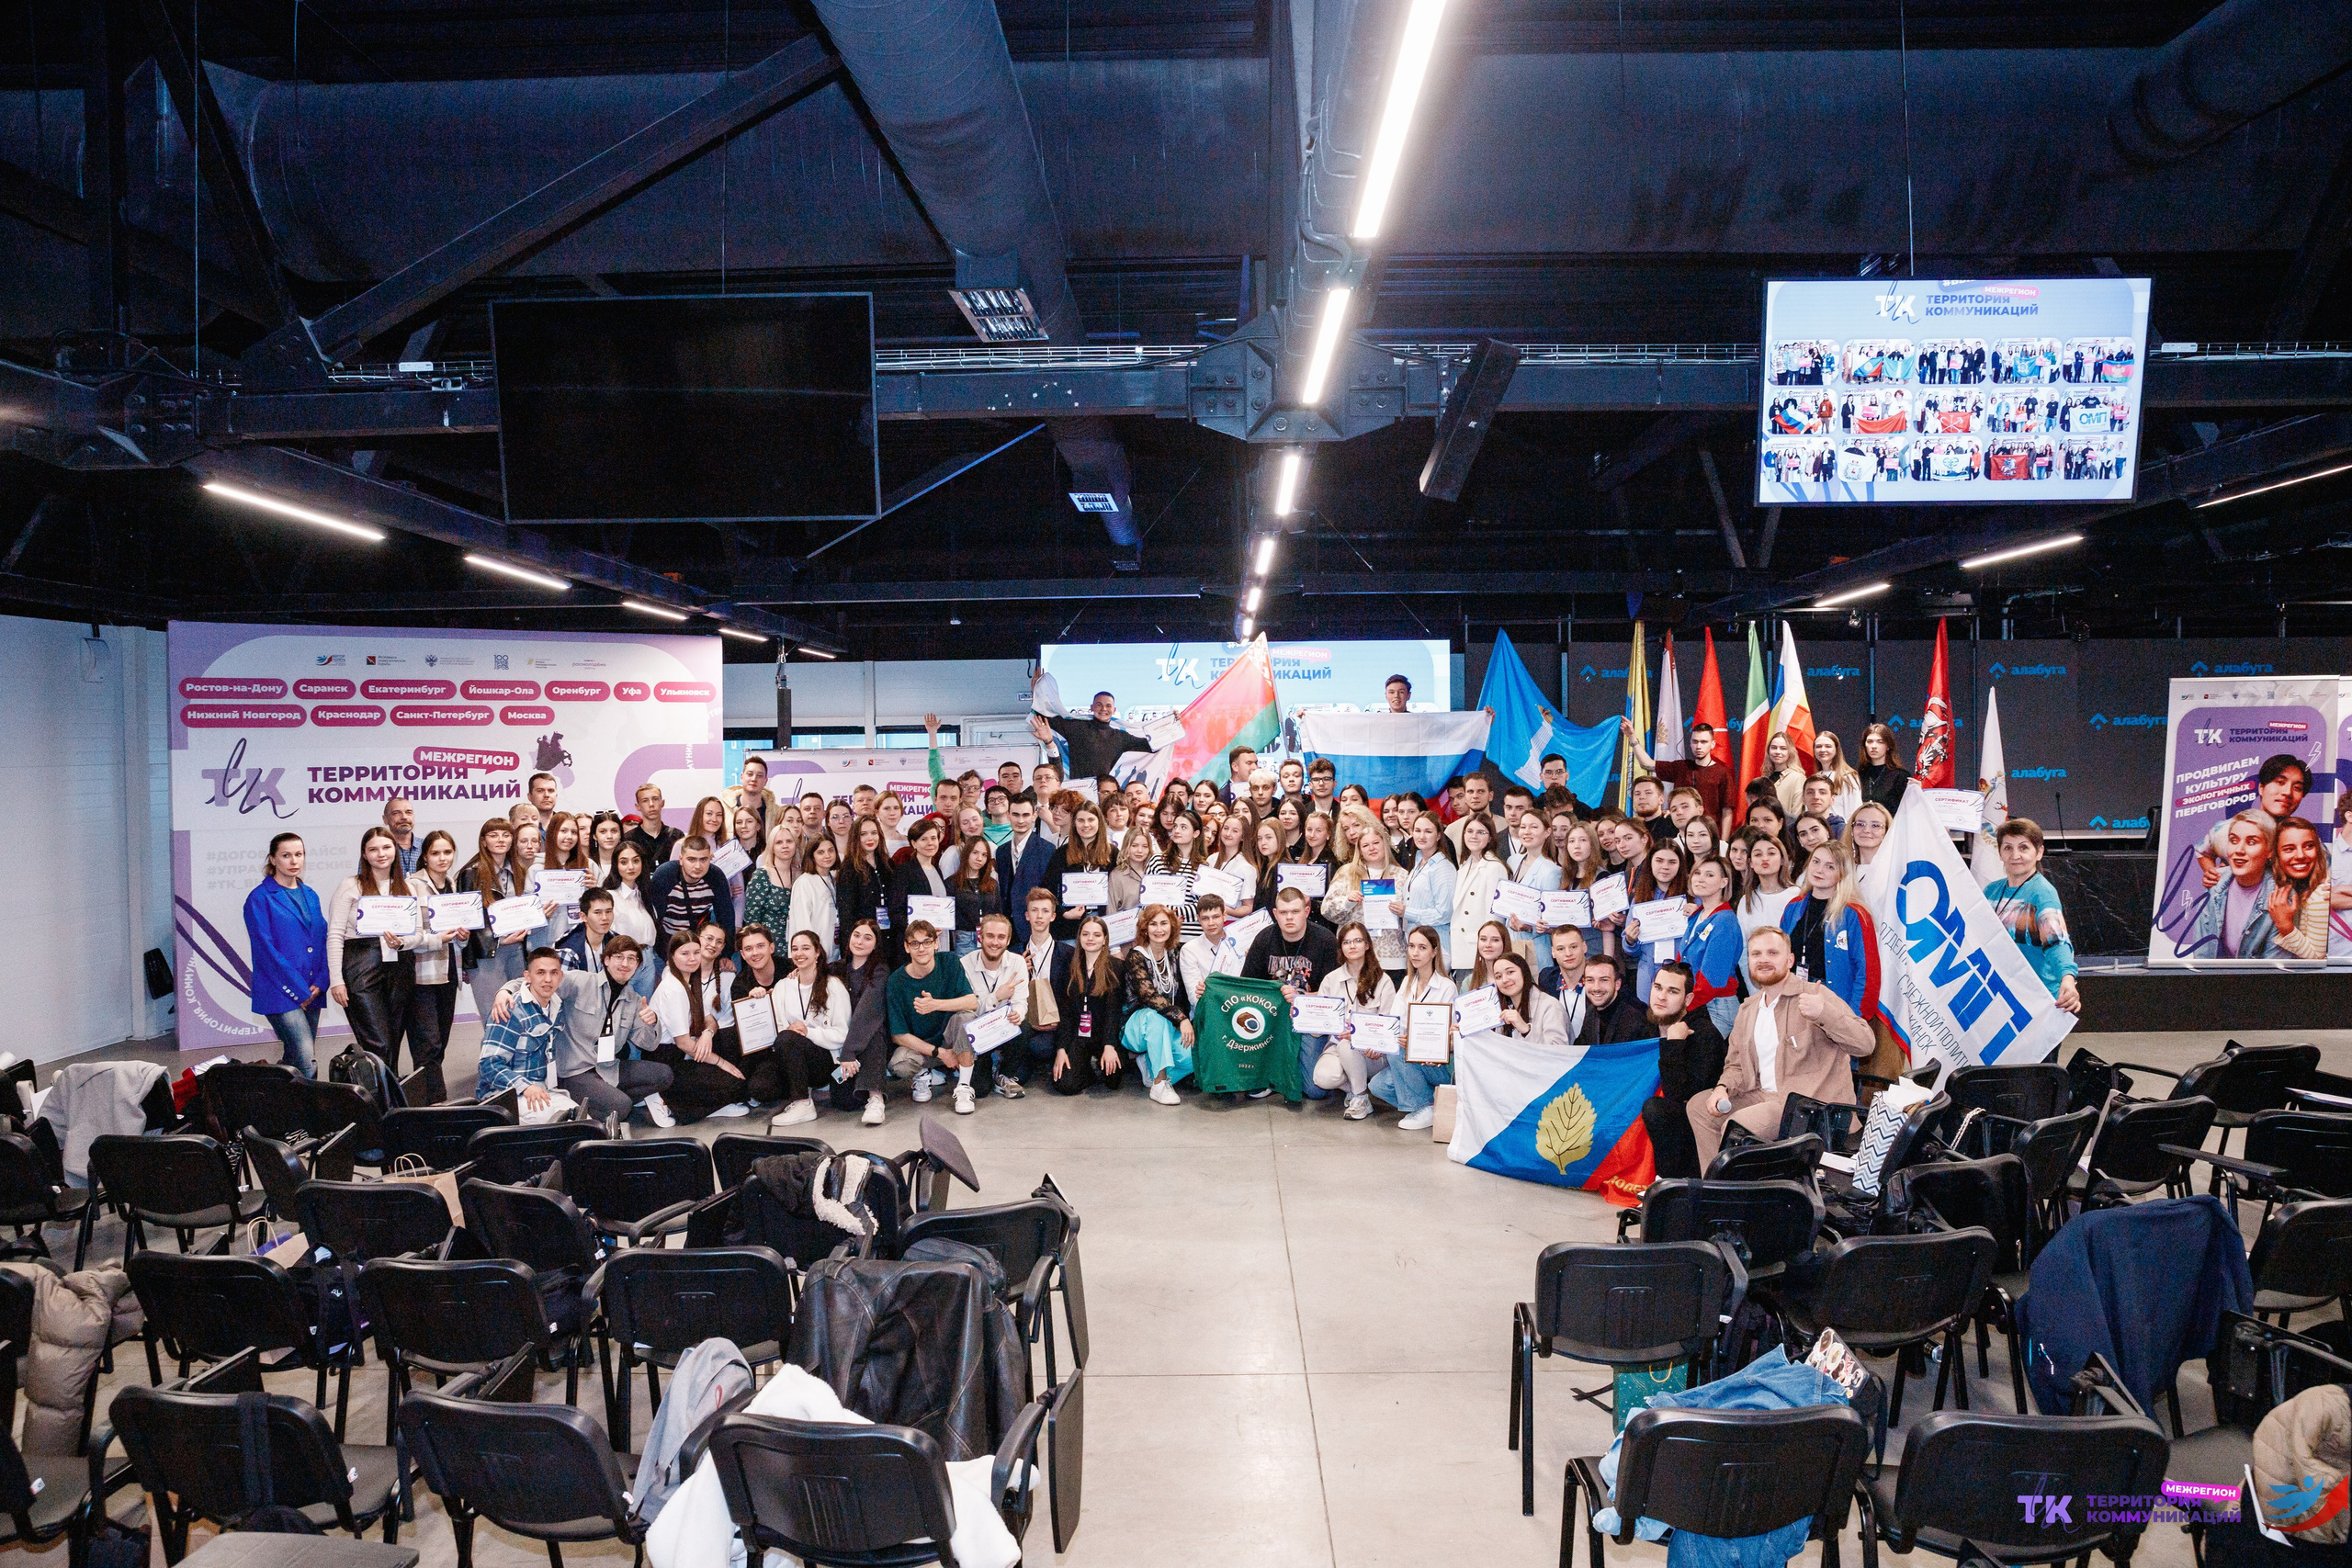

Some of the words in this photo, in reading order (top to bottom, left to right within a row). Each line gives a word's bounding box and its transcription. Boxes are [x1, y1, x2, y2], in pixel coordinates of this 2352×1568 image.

[1984, 286, 2037, 296] МЕЖРЕГИОН
[1926, 294, 2010, 304] ТЕРРИТОРИЯ
[1925, 303, 2039, 317] КОММУНИКАЦИЙ
[1272, 648, 1328, 659] МЕЖРЕГИОН
[1806, 665, 1860, 678] алабуга
[2011, 665, 2066, 678] алабуга
[2213, 662, 2274, 676] алабуга
[186, 682, 283, 694] Ростов-на-Дону
[299, 683, 348, 695] Саранск
[368, 684, 447, 695] Екатеринбург
[469, 683, 535, 696] Йошкар-Ола
[552, 686, 602, 696] Оренбург
[622, 687, 642, 696] Уфа
[660, 688, 710, 696] Ульяновск
[187, 709, 239, 720] Нижний
[243, 711, 301, 721] Новгород
[318, 710, 381, 721] Краснодар
[396, 710, 490, 721] Санкт-Петербург
[507, 711, 547, 720] Москва
[2268, 721, 2307, 730] МЕЖРЕГИОН
[2230, 728, 2289, 736] ТЕРРИТОРИЯ
[2229, 733, 2309, 744] КОММУНИКАЦИЙ
[419, 750, 514, 767] МЕЖРЕГИОН
[307, 765, 469, 784] ТЕРРИТОРИЯ
[2011, 766, 2066, 779] алабуга
[2176, 756, 2260, 784] ПРОДВИГАЕМ
[2185, 771, 2249, 795] КУЛЬТУРУ
[307, 778, 521, 805] КОММУНИКАЦИЙ
[2182, 782, 2250, 806] ЭКОЛОГИЧНЫХ
[2174, 792, 2256, 818] ПЕРЕГОВОРОВ
[1220, 995, 1239, 1013] СПО
[1240, 994, 1278, 1017] «КОКОС»
[1227, 1034, 1274, 1054] Дзержинск
